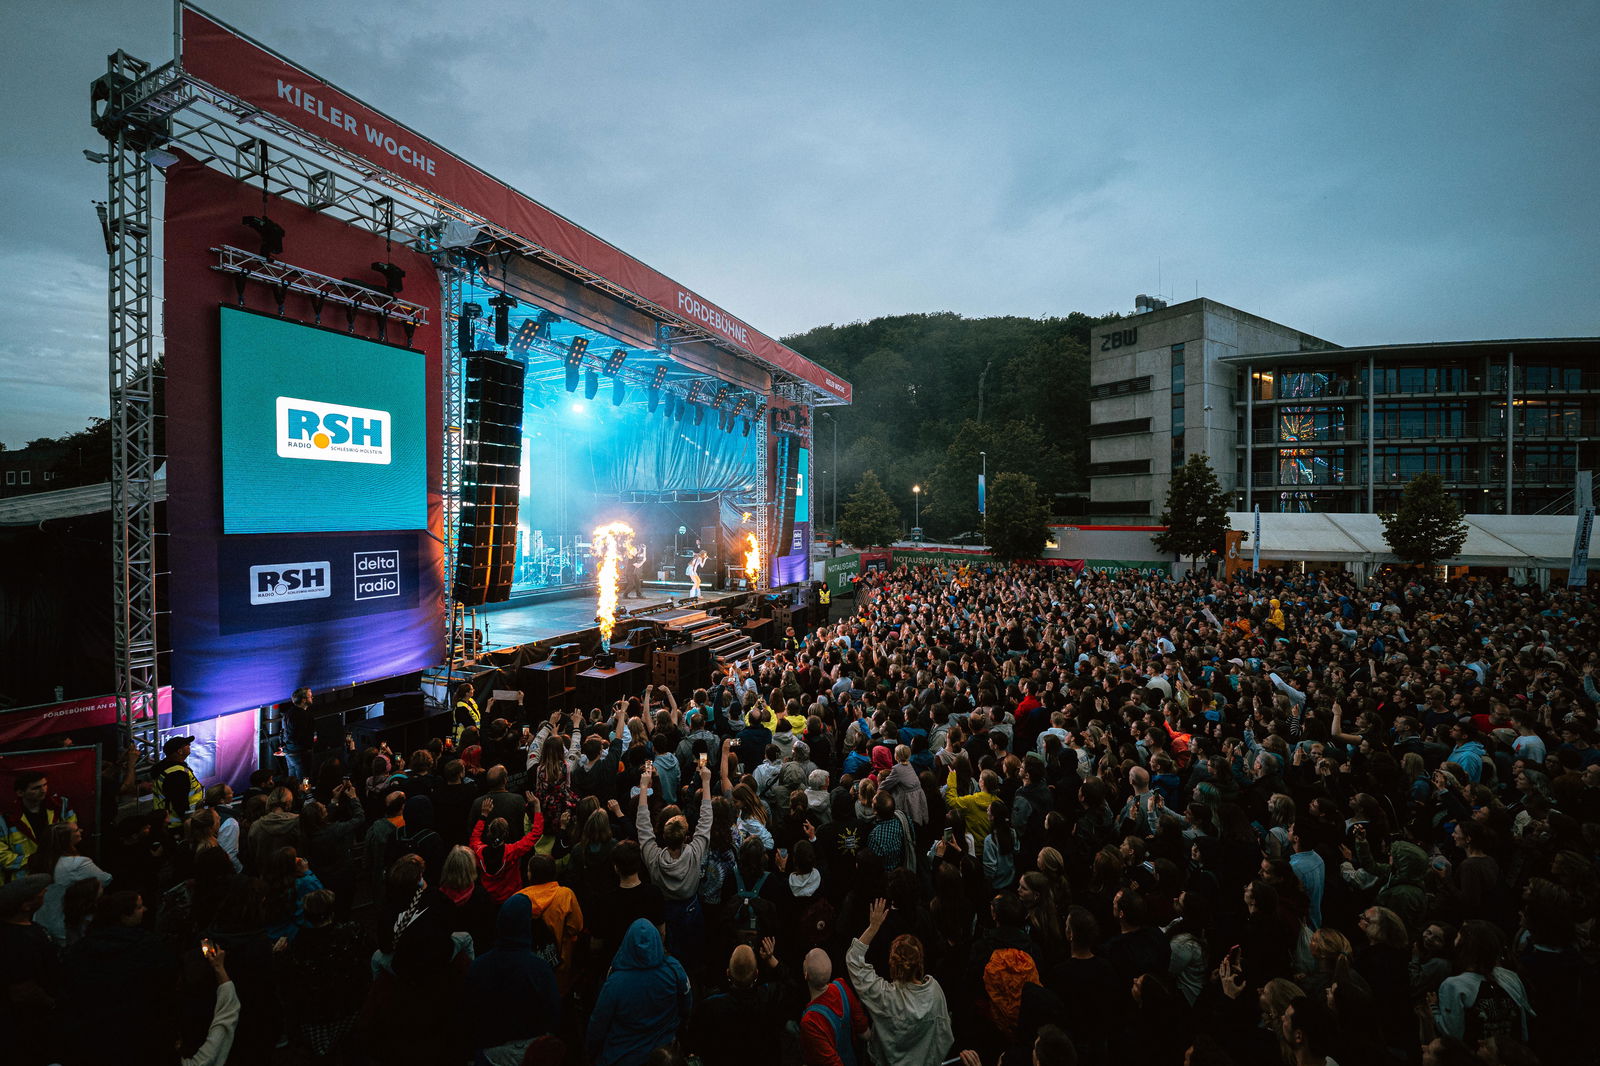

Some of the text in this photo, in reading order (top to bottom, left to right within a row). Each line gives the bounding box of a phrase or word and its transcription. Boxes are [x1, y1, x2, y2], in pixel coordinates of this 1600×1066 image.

[276, 79, 436, 177] KIELER WOCHE
[678, 291, 747, 344] FÖRDEBÜHNE
[1099, 327, 1138, 352] ZBW
[287, 408, 382, 447] RSH
[287, 441, 312, 449] RADIO
[358, 556, 395, 571] delta
[258, 568, 325, 592] RSH
[359, 577, 396, 594] radio
[43, 706, 95, 719] FÖRDEBÜHNE
[97, 703, 107, 711] AN
